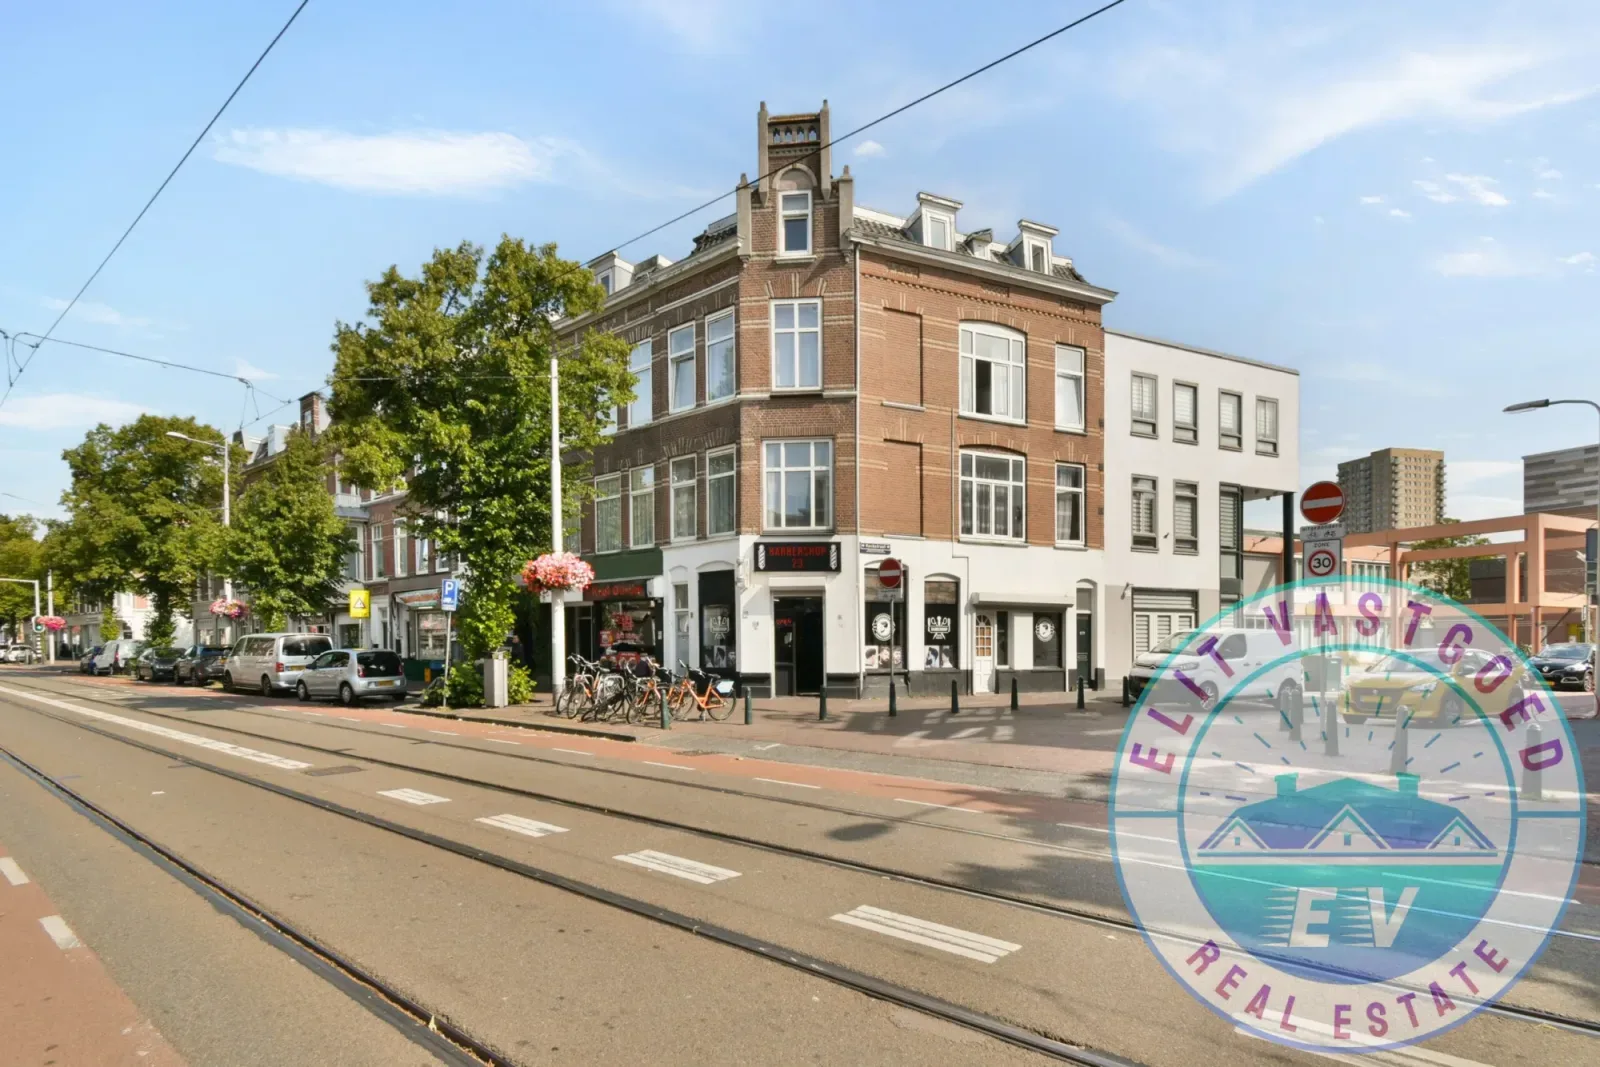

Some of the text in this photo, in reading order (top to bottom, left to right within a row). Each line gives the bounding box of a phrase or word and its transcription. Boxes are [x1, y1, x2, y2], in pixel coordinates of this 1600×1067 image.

[769, 546, 826, 557] BARBERSHOP
[1313, 558, 1331, 569] 30
[445, 581, 454, 595] P
